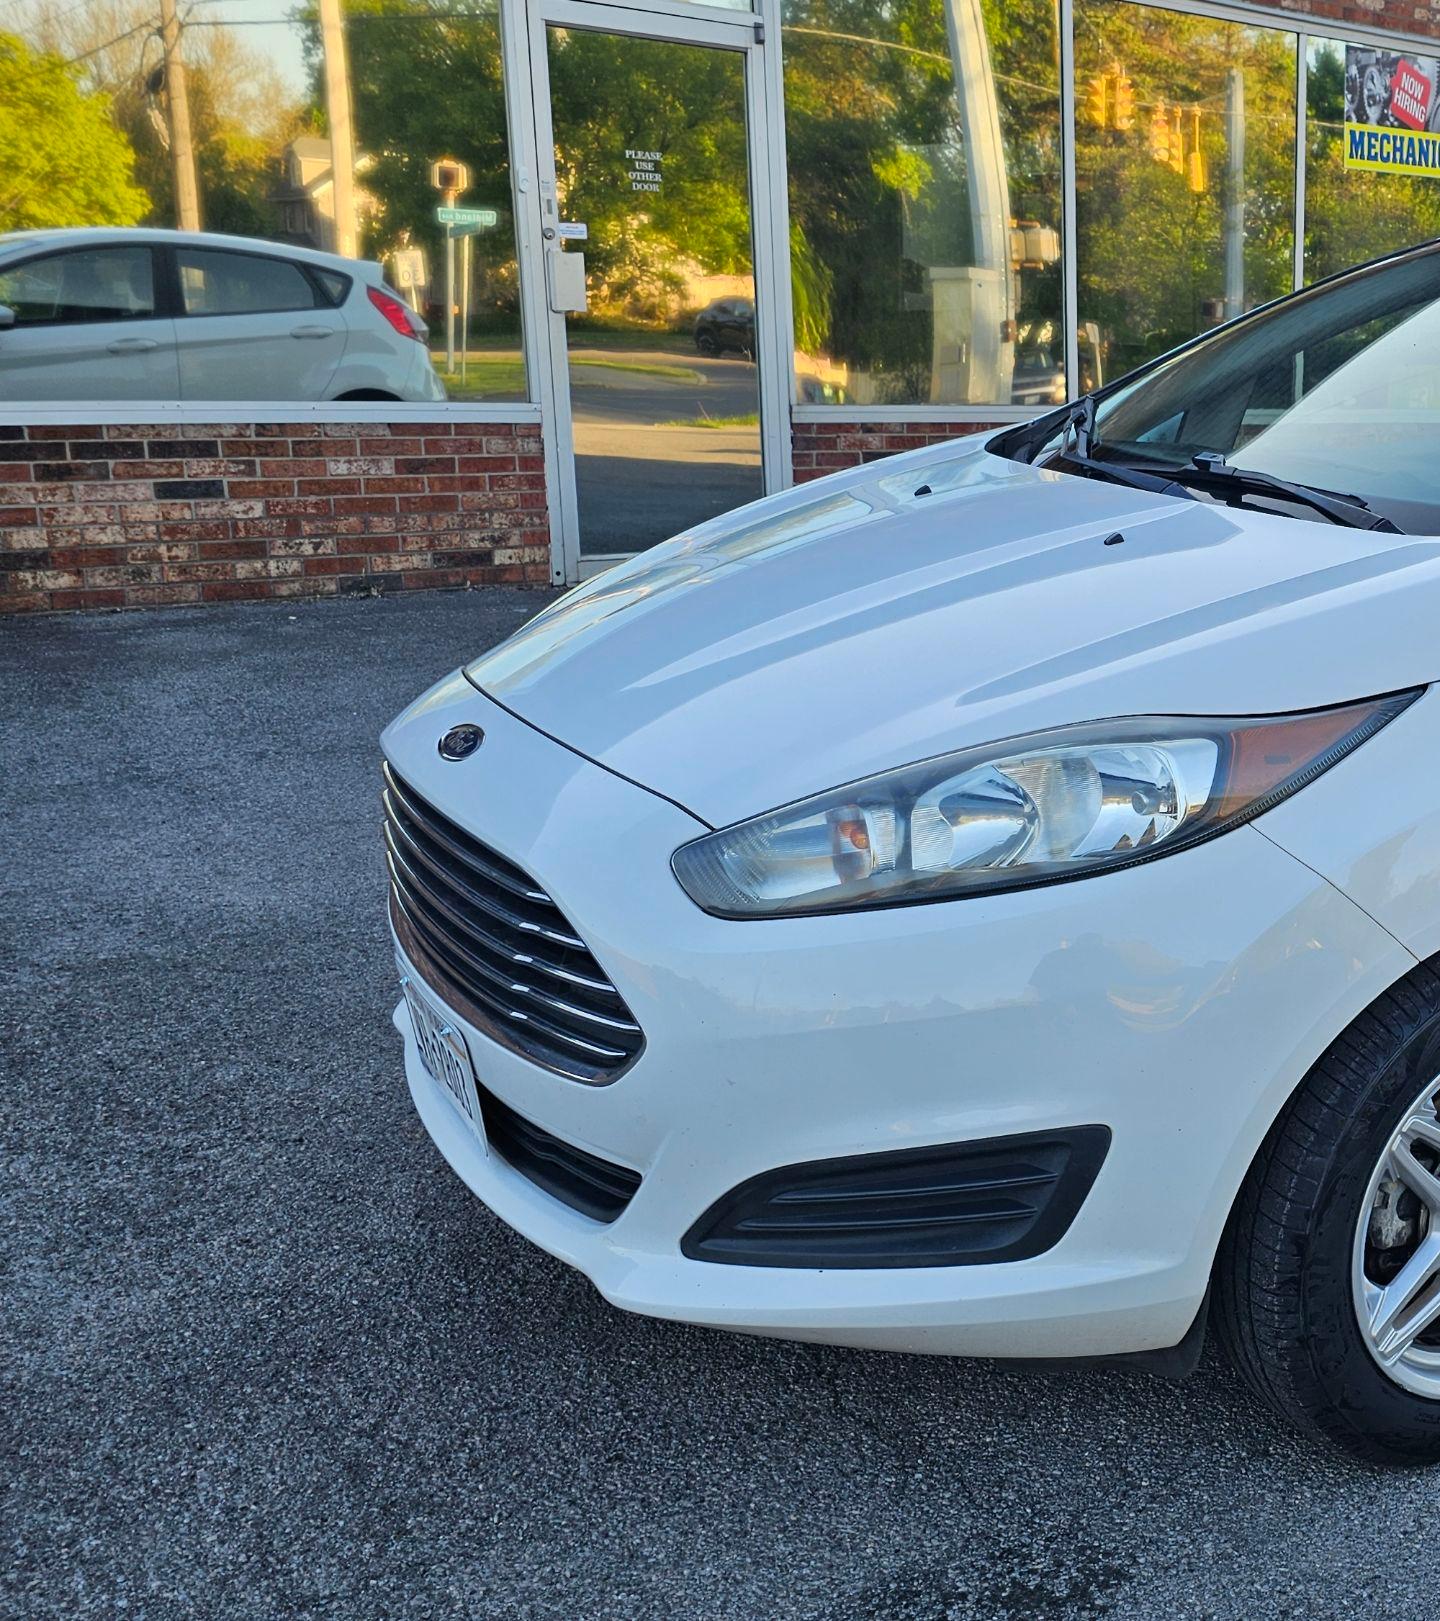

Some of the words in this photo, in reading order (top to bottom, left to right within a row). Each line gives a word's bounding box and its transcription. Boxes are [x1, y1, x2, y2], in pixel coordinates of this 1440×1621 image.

[1401, 72, 1424, 100] NOW
[1394, 88, 1426, 123] HIRING
[625, 150, 663, 160] PLEASE
[635, 161, 655, 171] USE
[628, 171, 662, 181] OTHER
[632, 182, 660, 192] DOOR
